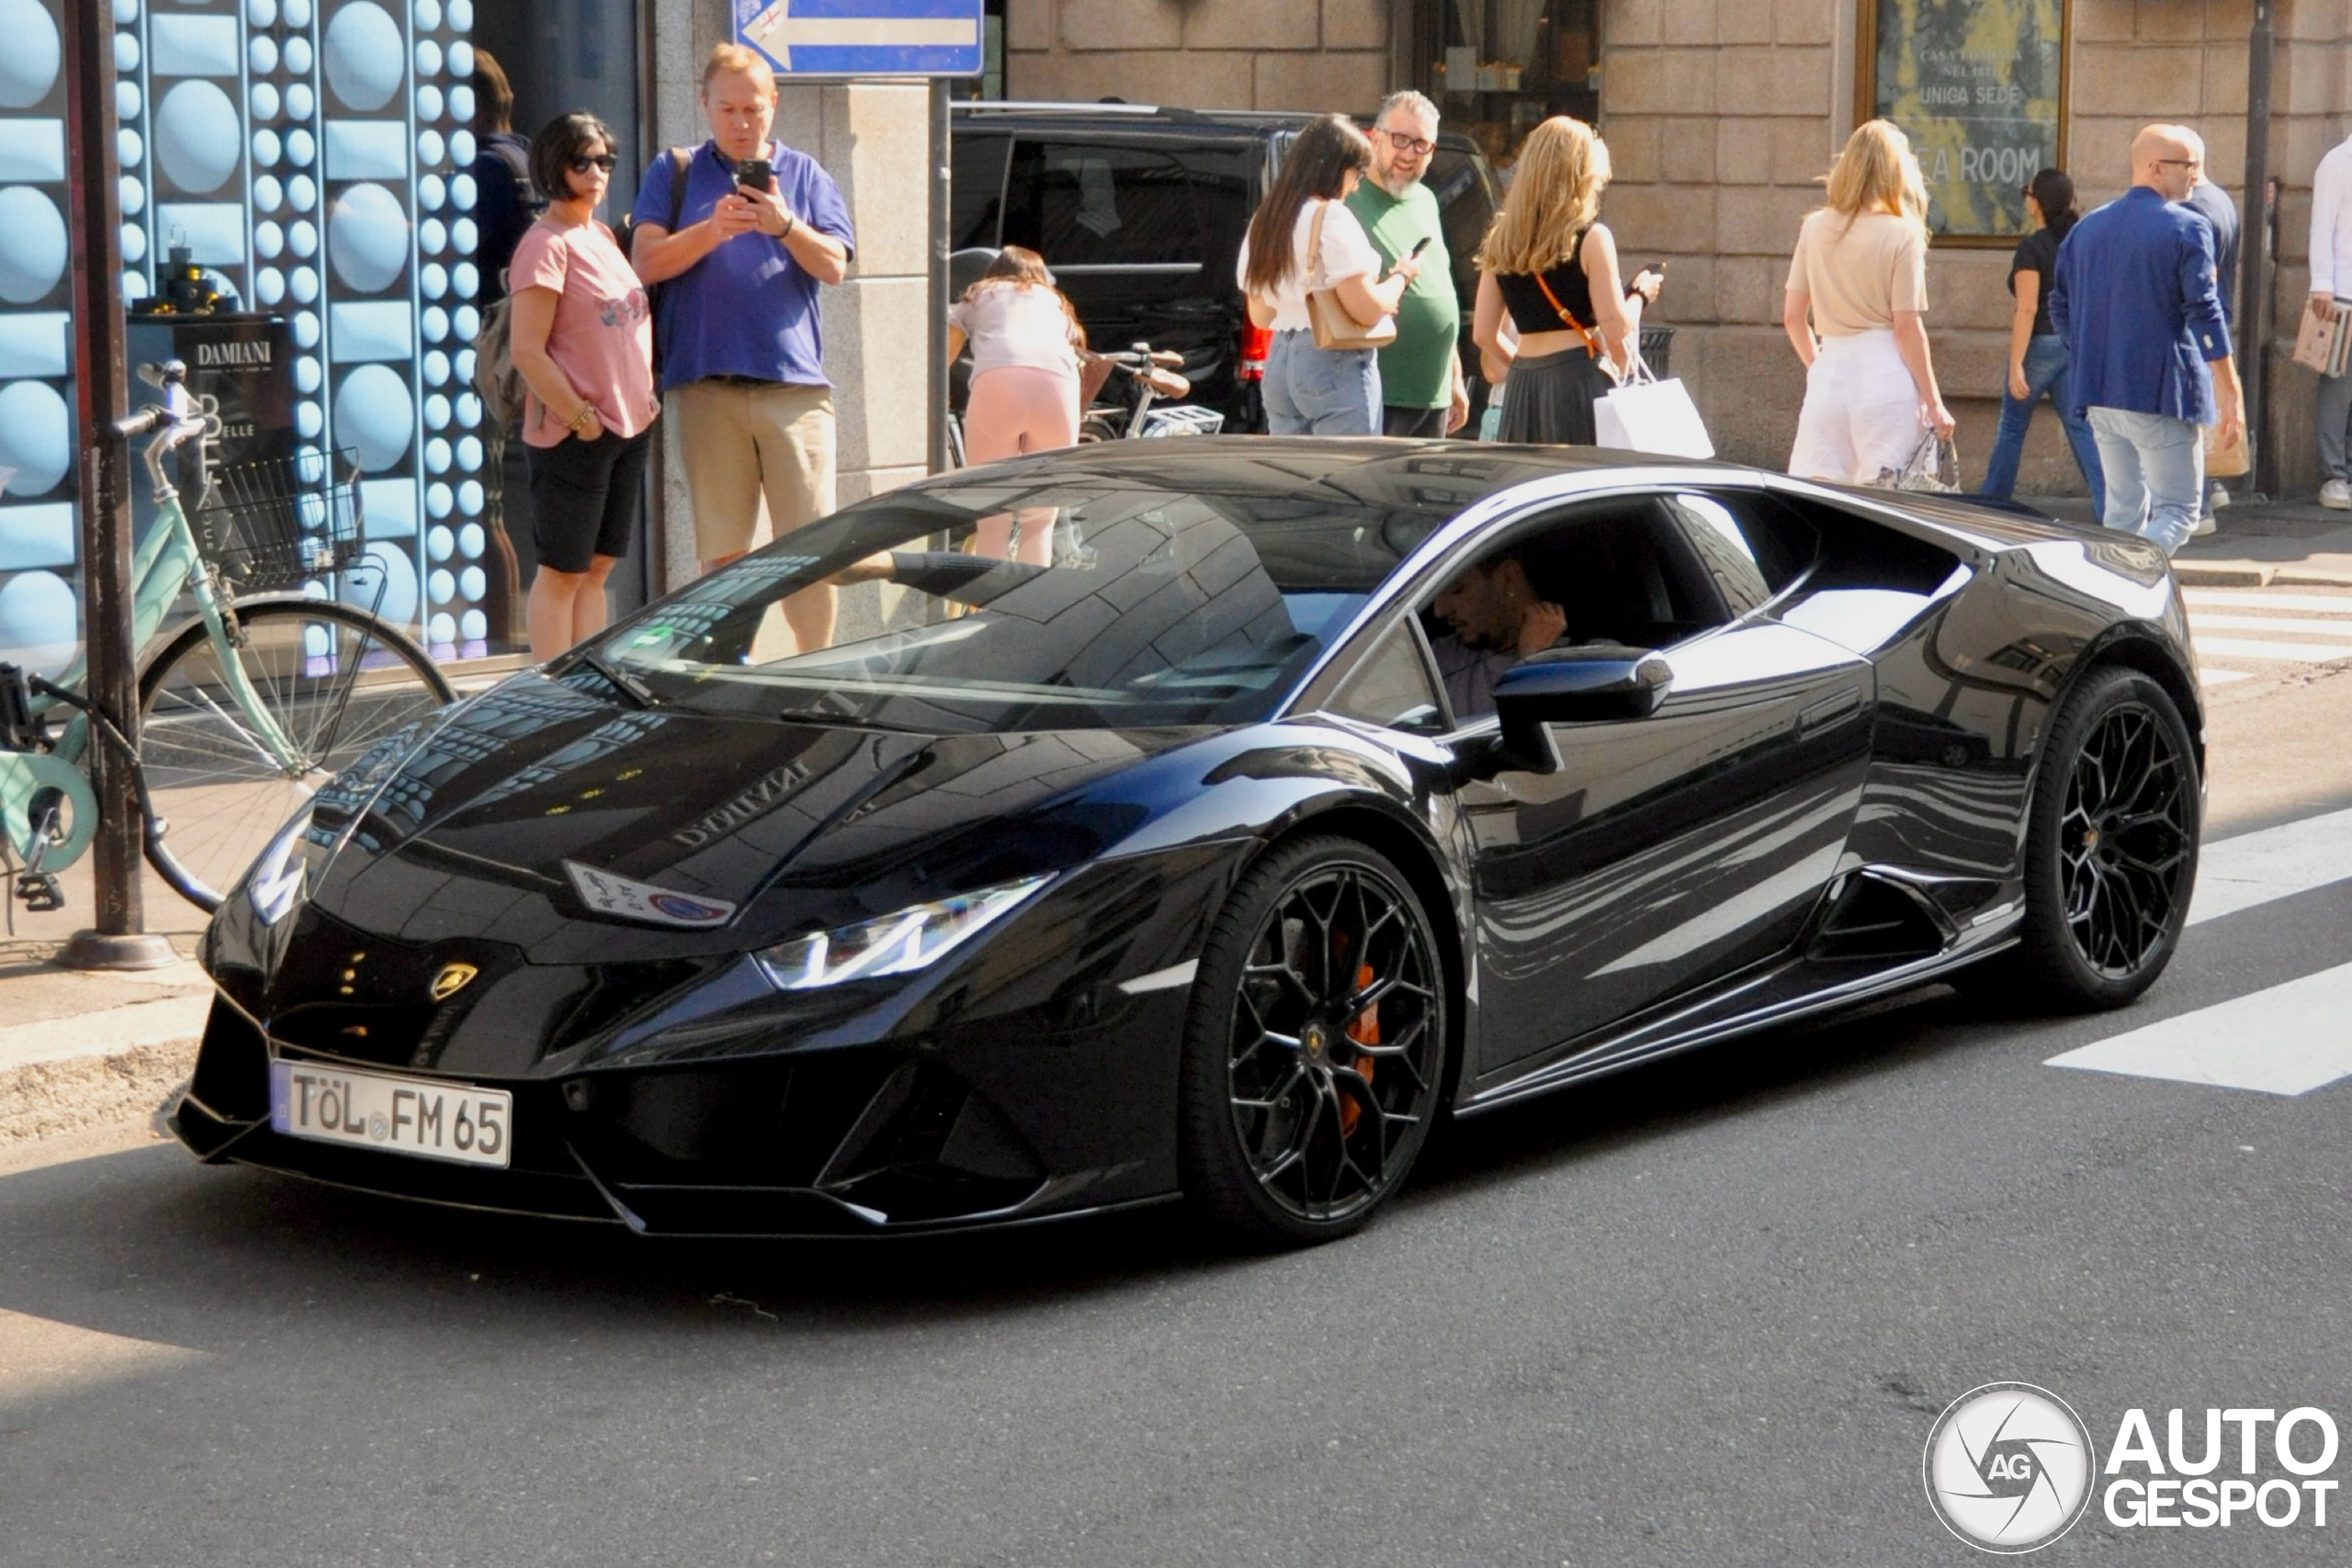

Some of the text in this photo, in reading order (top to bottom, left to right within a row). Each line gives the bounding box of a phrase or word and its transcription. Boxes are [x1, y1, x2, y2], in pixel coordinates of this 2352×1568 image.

[1920, 50, 1955, 62] CASA
[1919, 86, 2019, 105] UNICA SEDE
[1960, 146, 2041, 184] ROOM
[198, 341, 272, 366] DAMIANI
[292, 1074, 366, 1135] TÖL
[390, 1089, 444, 1147] FM
[453, 1099, 503, 1156] 65
